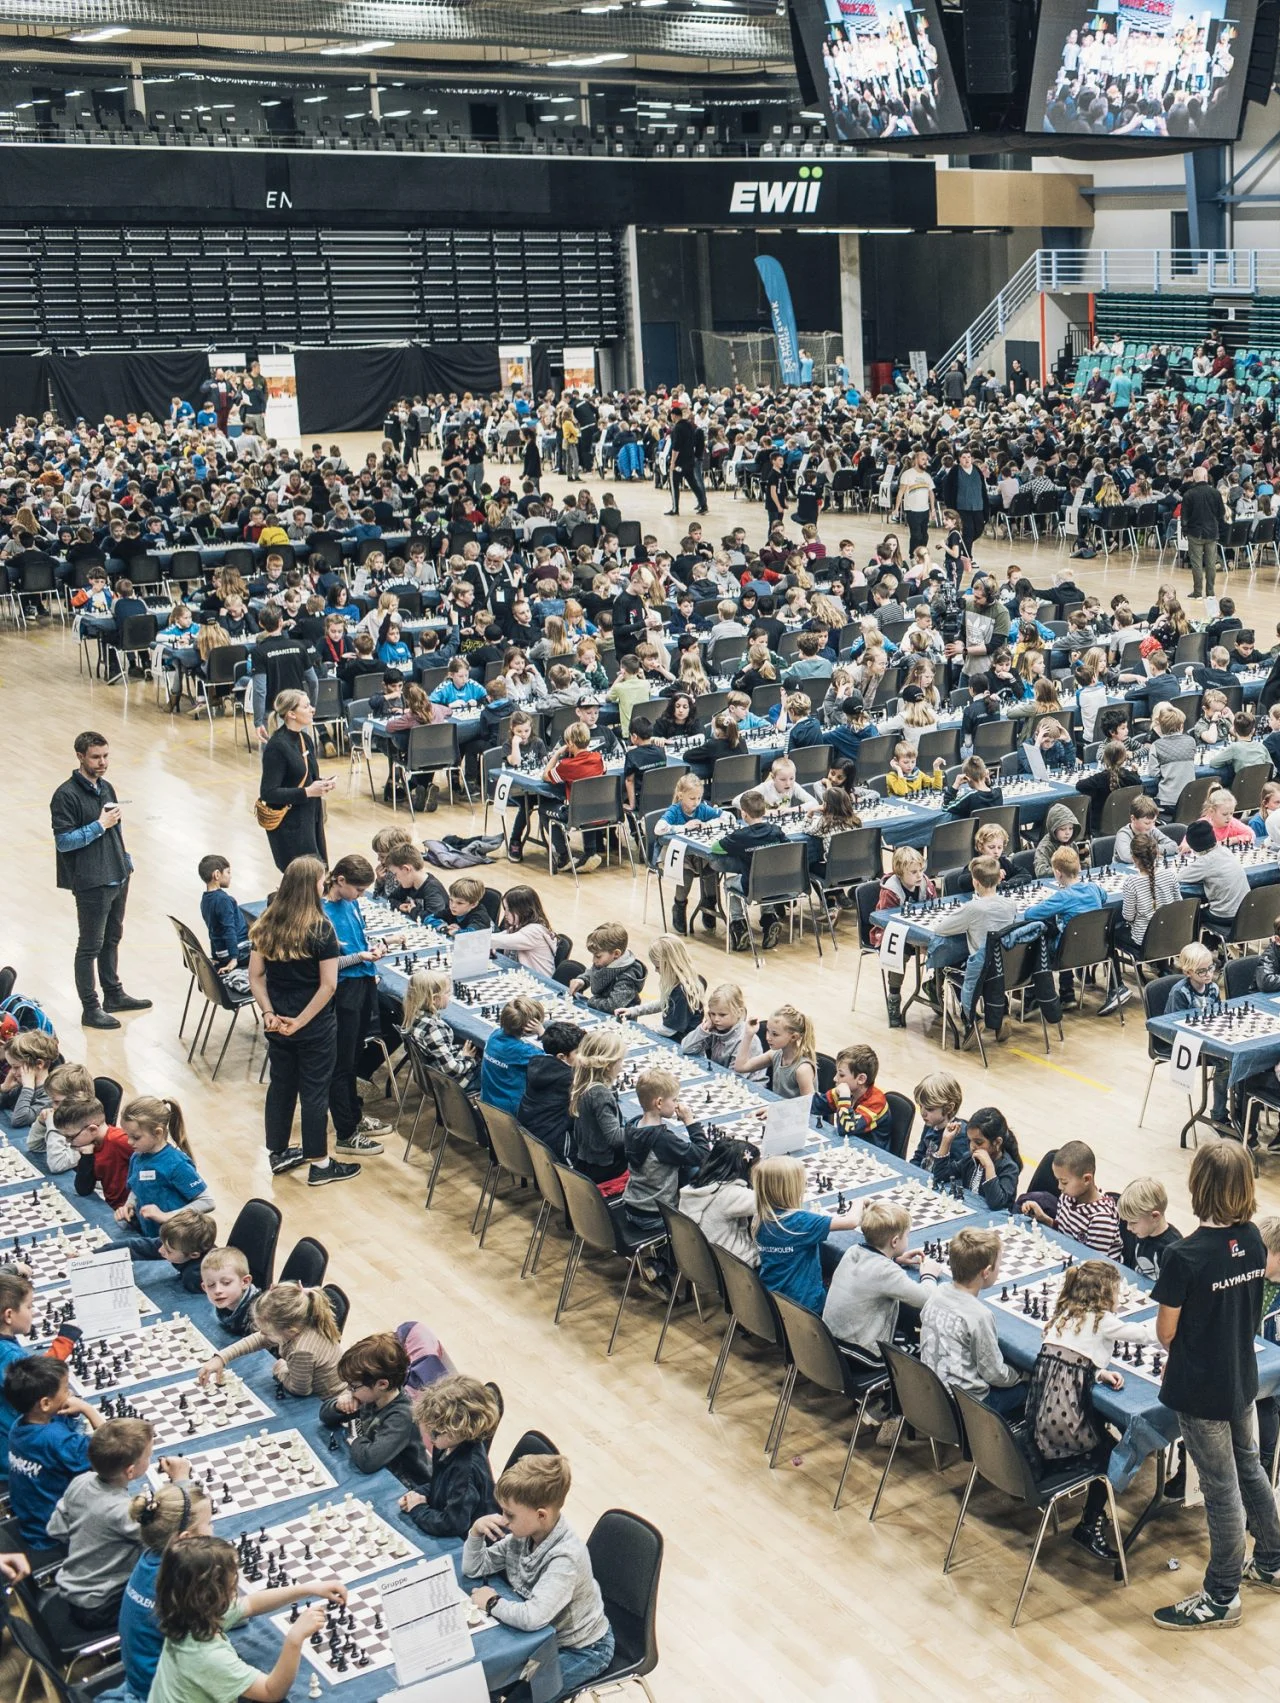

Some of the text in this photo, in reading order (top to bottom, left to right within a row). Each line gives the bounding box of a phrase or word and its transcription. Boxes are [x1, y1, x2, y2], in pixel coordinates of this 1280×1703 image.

[266, 191, 293, 209] EN
[881, 486, 888, 498] N
[1069, 512, 1074, 524] L
[363, 730, 370, 744] H
[498, 784, 506, 800] G
[670, 849, 680, 867] F
[887, 933, 899, 955] E
[1176, 1045, 1191, 1071] D
[71, 1260, 94, 1268] Gruppe
[381, 1576, 408, 1591] Gruppe
